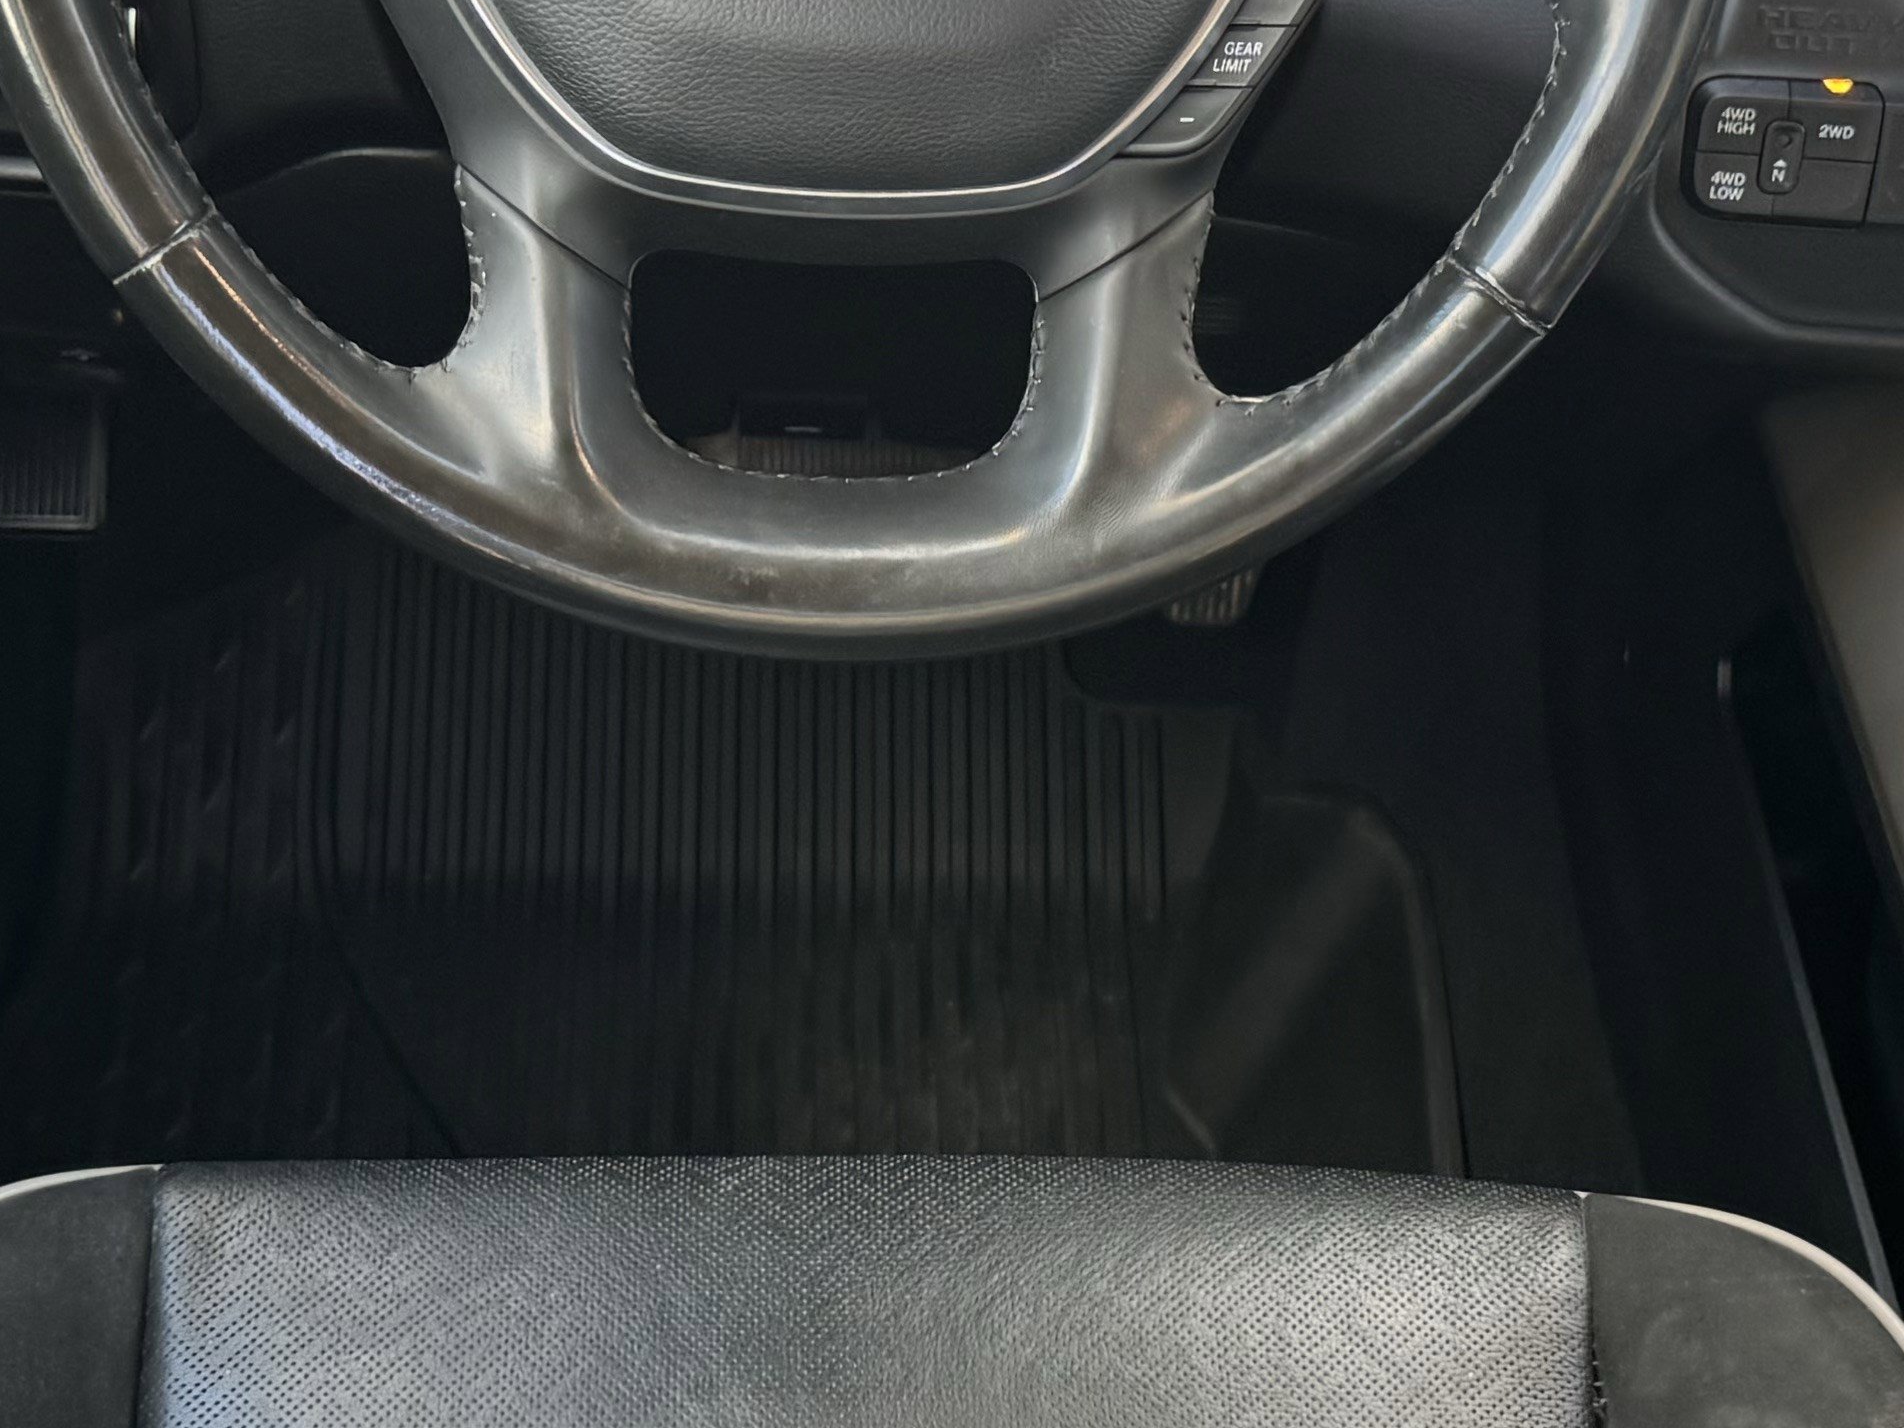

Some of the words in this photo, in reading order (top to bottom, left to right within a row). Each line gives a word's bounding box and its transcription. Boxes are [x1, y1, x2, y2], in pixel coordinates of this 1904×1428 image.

[1223, 40, 1264, 57] GEAR
[1212, 58, 1252, 74] LIMIT
[1720, 106, 1757, 121] 4WD
[1716, 121, 1756, 136] HIGH
[1818, 123, 1856, 140] 2WD
[1710, 170, 1747, 187] 4WD
[1771, 168, 1785, 183] N
[1709, 185, 1745, 201] LOW
